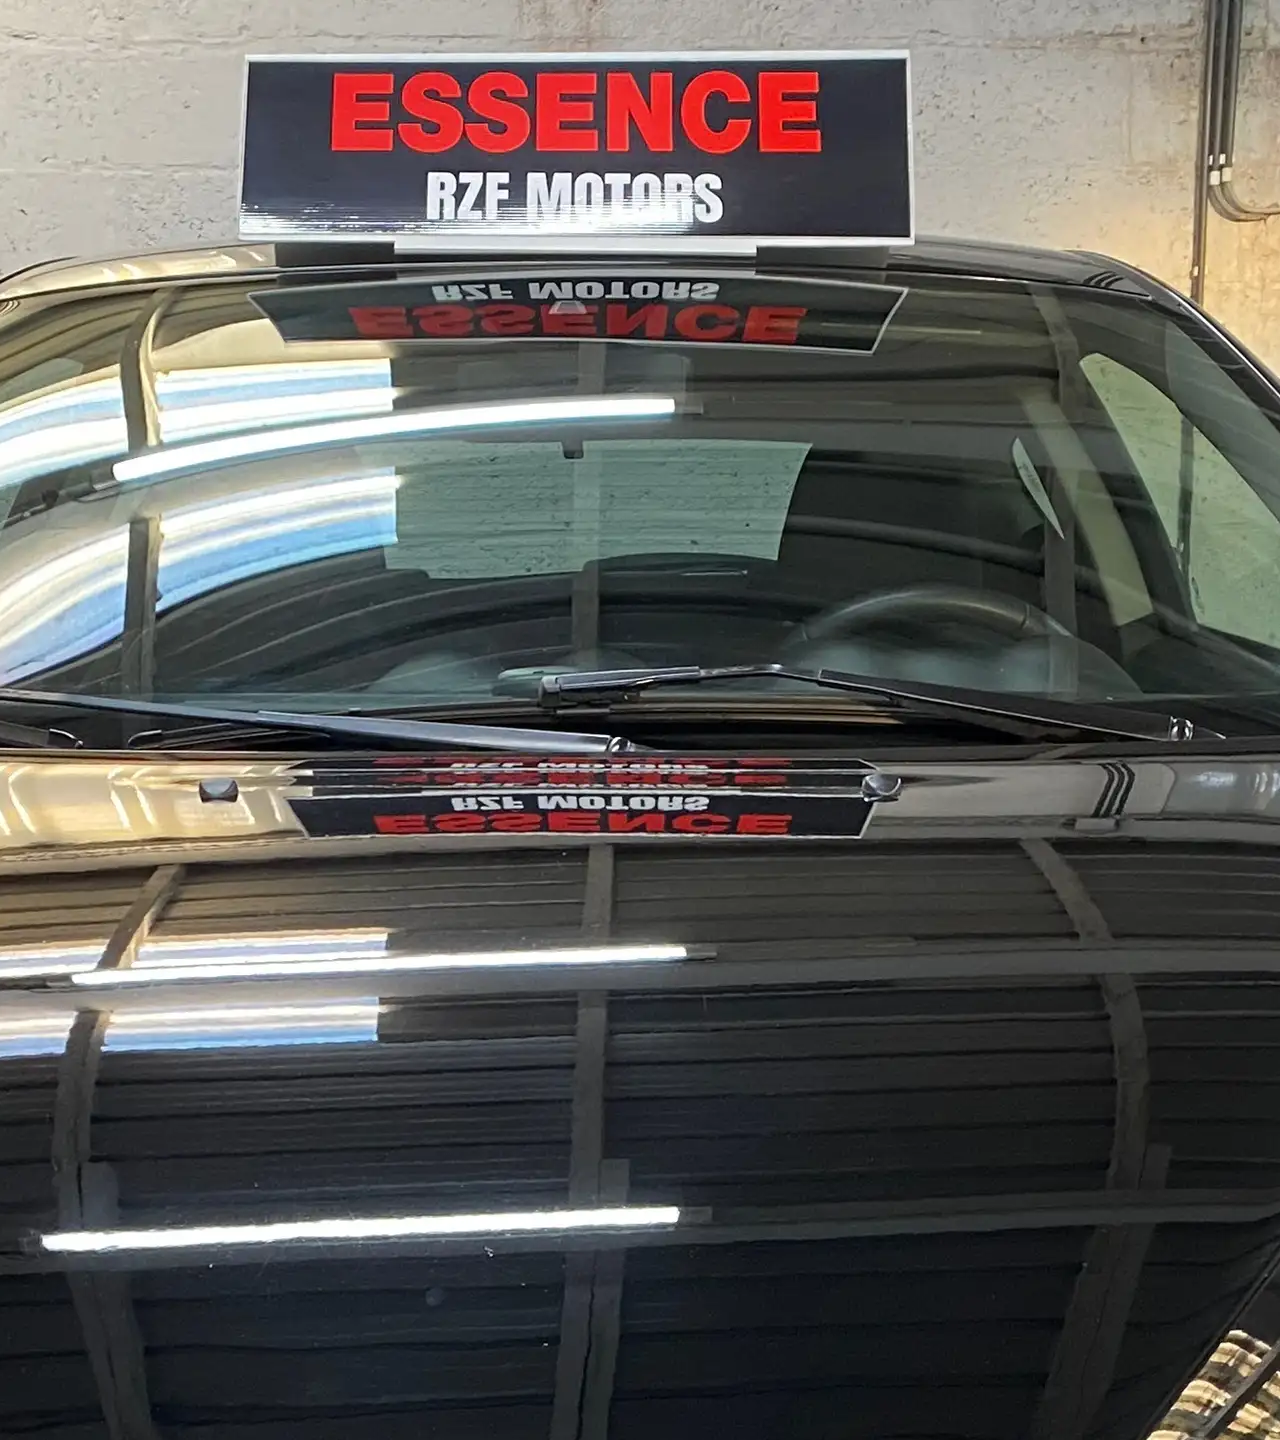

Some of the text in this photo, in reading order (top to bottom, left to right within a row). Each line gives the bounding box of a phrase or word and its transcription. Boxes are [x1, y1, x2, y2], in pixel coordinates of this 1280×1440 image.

[330, 71, 822, 154] ESSENCE
[426, 171, 724, 225] RZF MOTORS
